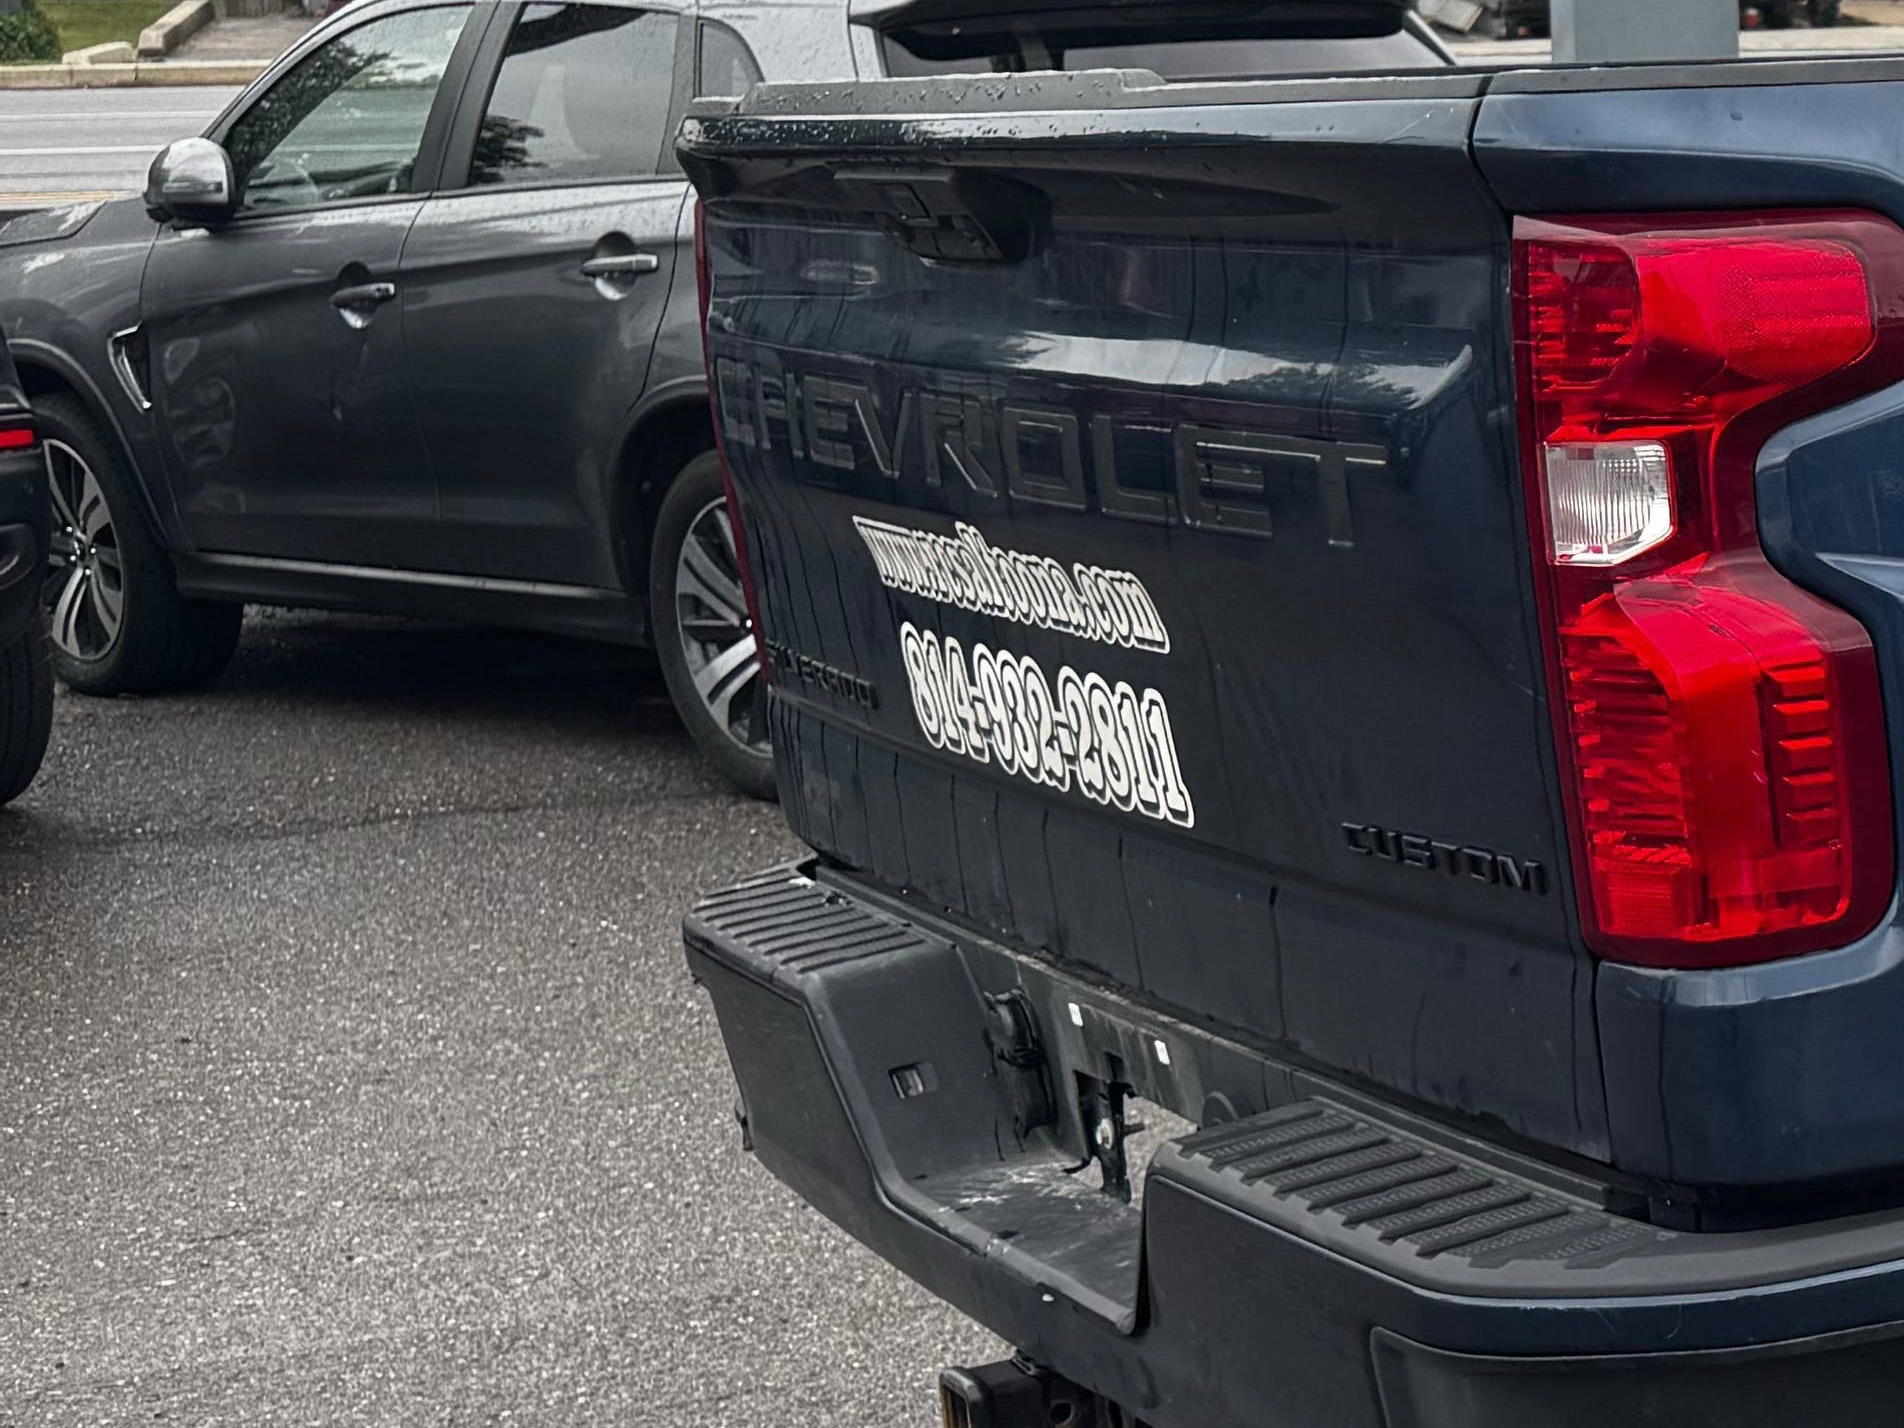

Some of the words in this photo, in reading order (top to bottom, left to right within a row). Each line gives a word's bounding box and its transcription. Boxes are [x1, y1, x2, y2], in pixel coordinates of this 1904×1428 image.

[714, 355, 1388, 549] CHEVROLET
[900, 622, 1194, 828] 814-932-2811
[1342, 822, 1548, 896] CUSTOM
